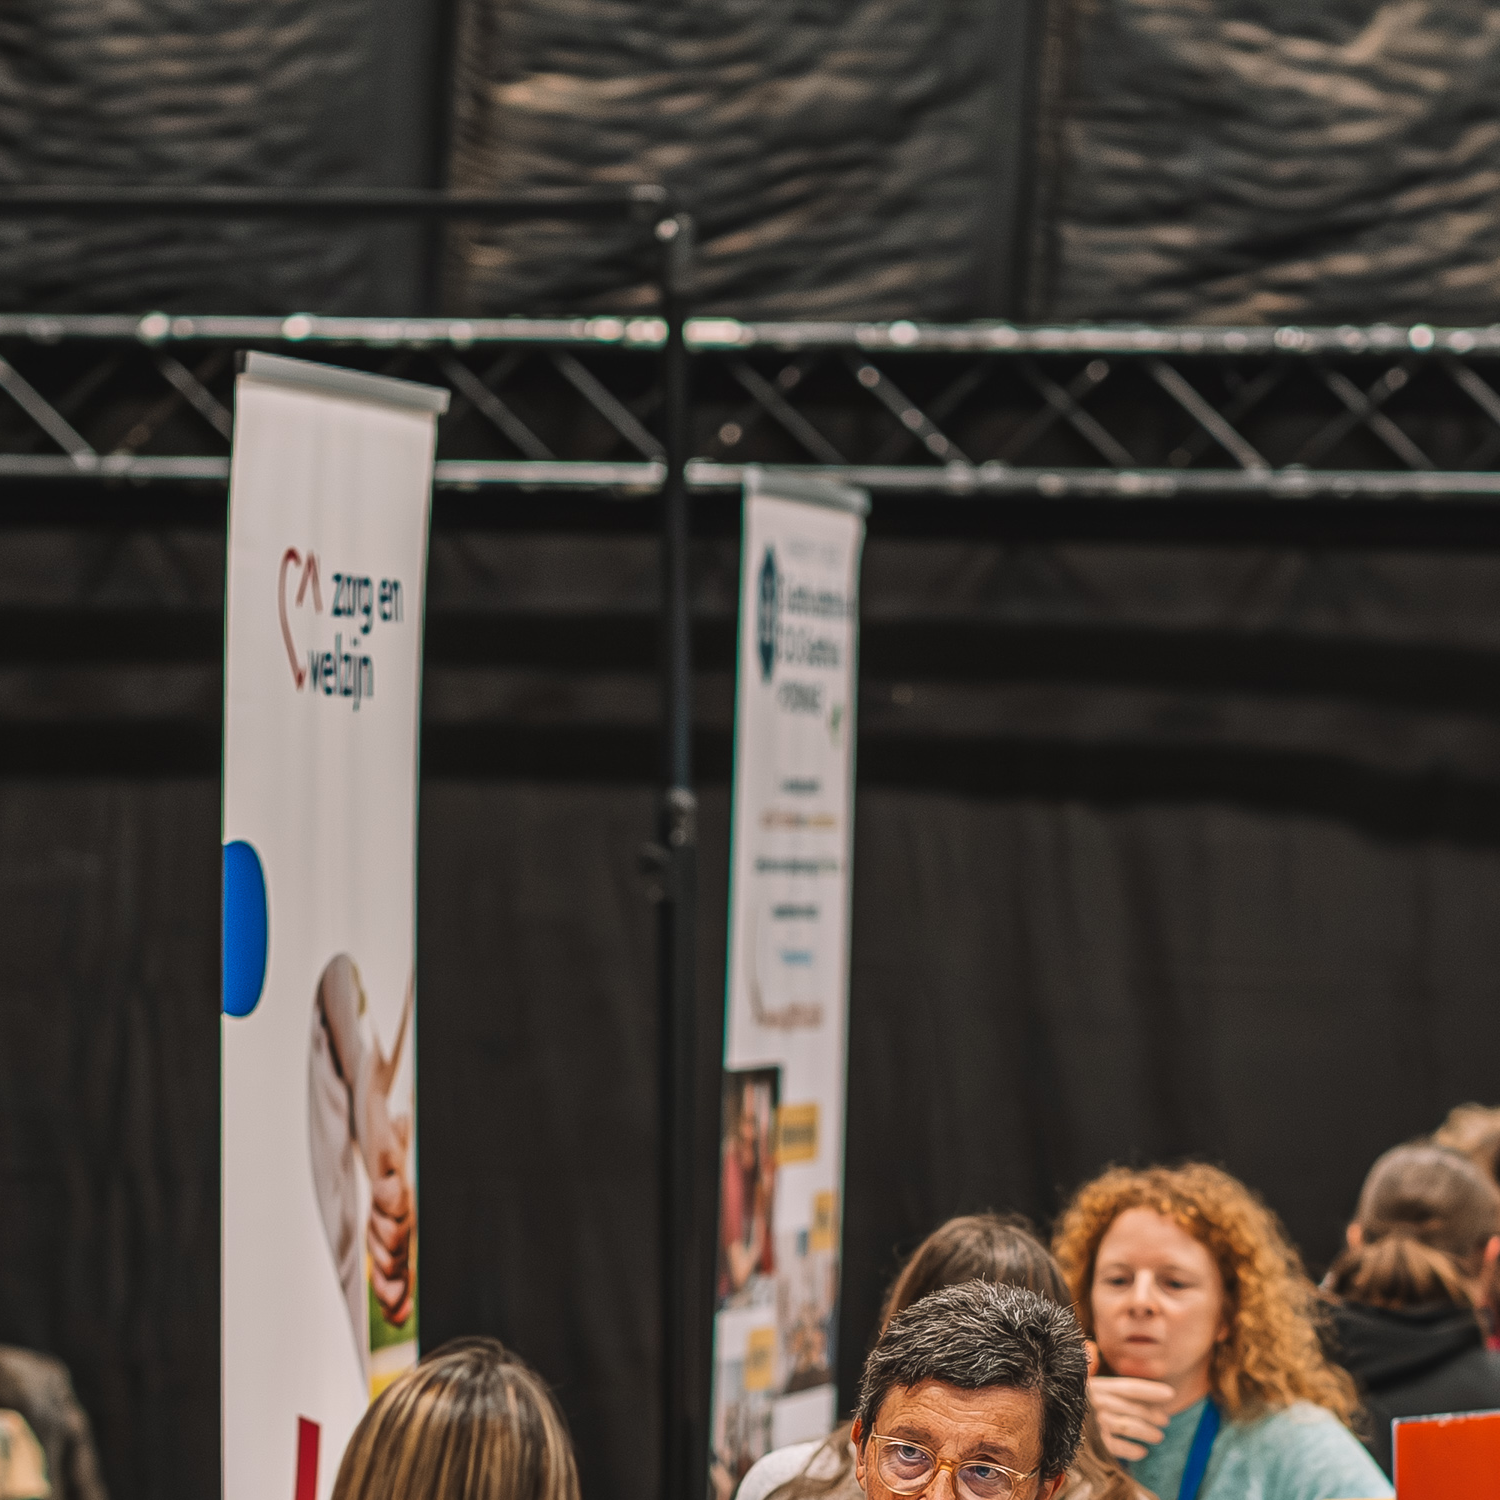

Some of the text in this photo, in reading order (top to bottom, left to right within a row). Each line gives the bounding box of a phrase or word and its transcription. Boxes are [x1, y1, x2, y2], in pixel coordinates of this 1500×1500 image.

[331, 573, 404, 635] zorg en
[307, 632, 374, 713] welzijn
